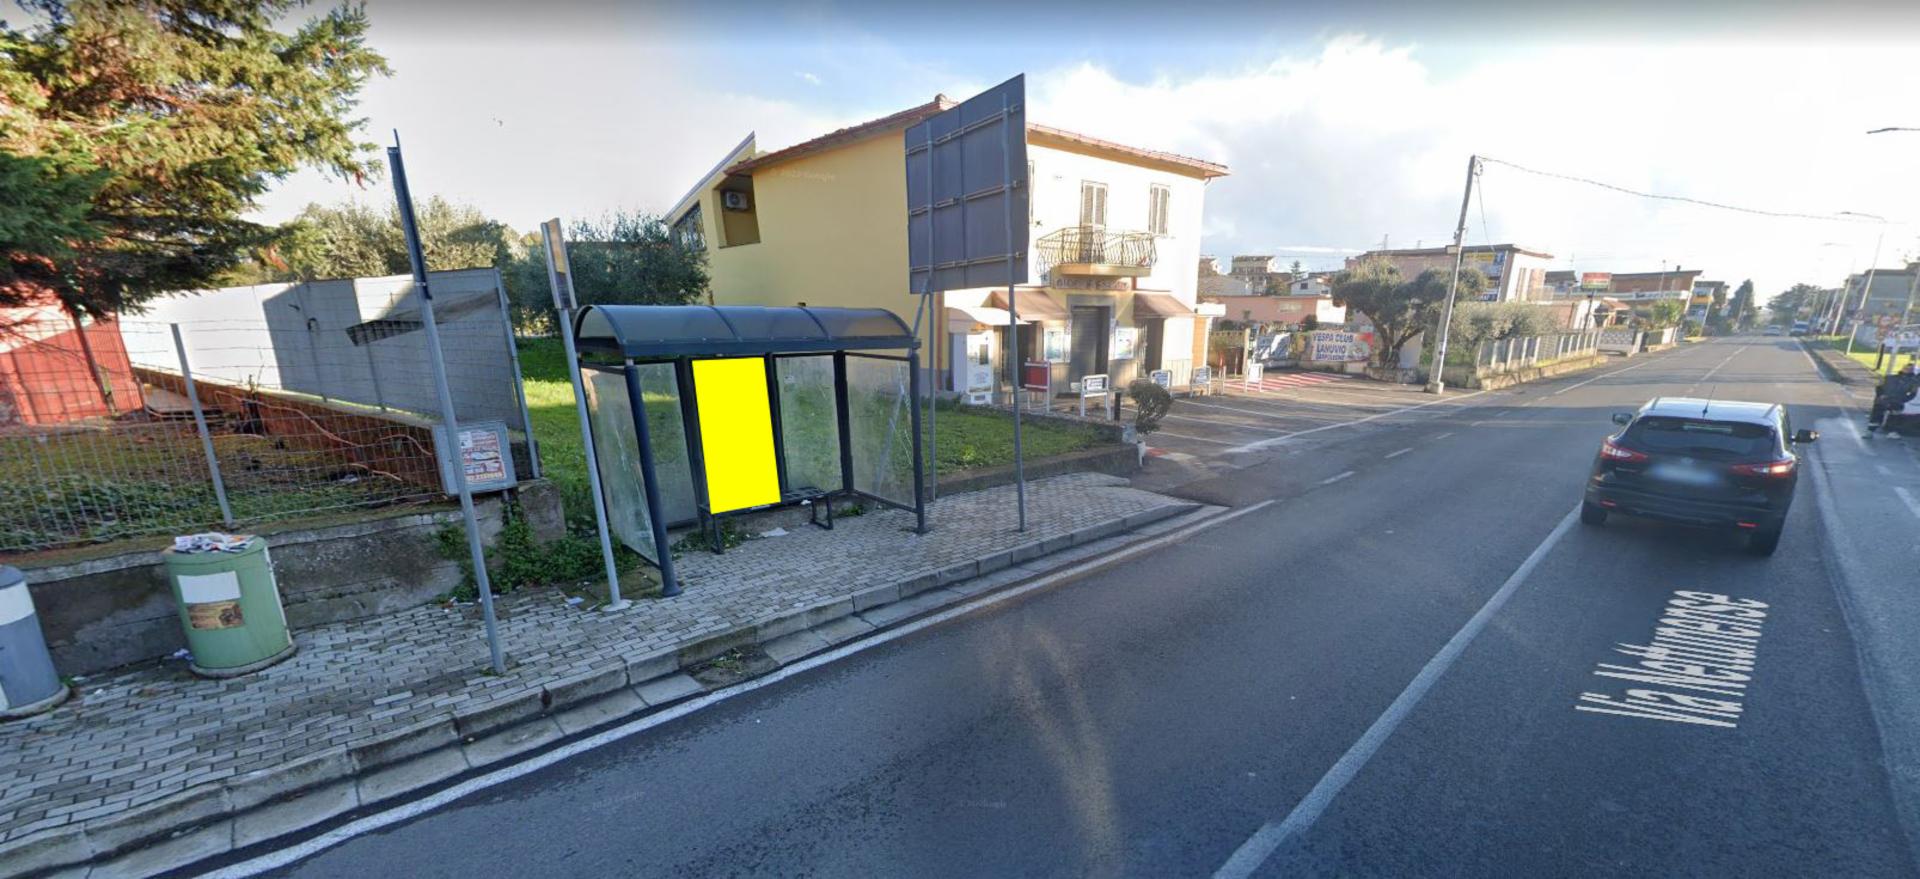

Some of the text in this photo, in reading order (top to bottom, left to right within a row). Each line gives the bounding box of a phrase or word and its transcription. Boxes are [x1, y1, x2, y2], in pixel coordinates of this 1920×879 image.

[1312, 333, 1354, 343] VESPA CLUB
[1316, 344, 1346, 354] LANUVIO
